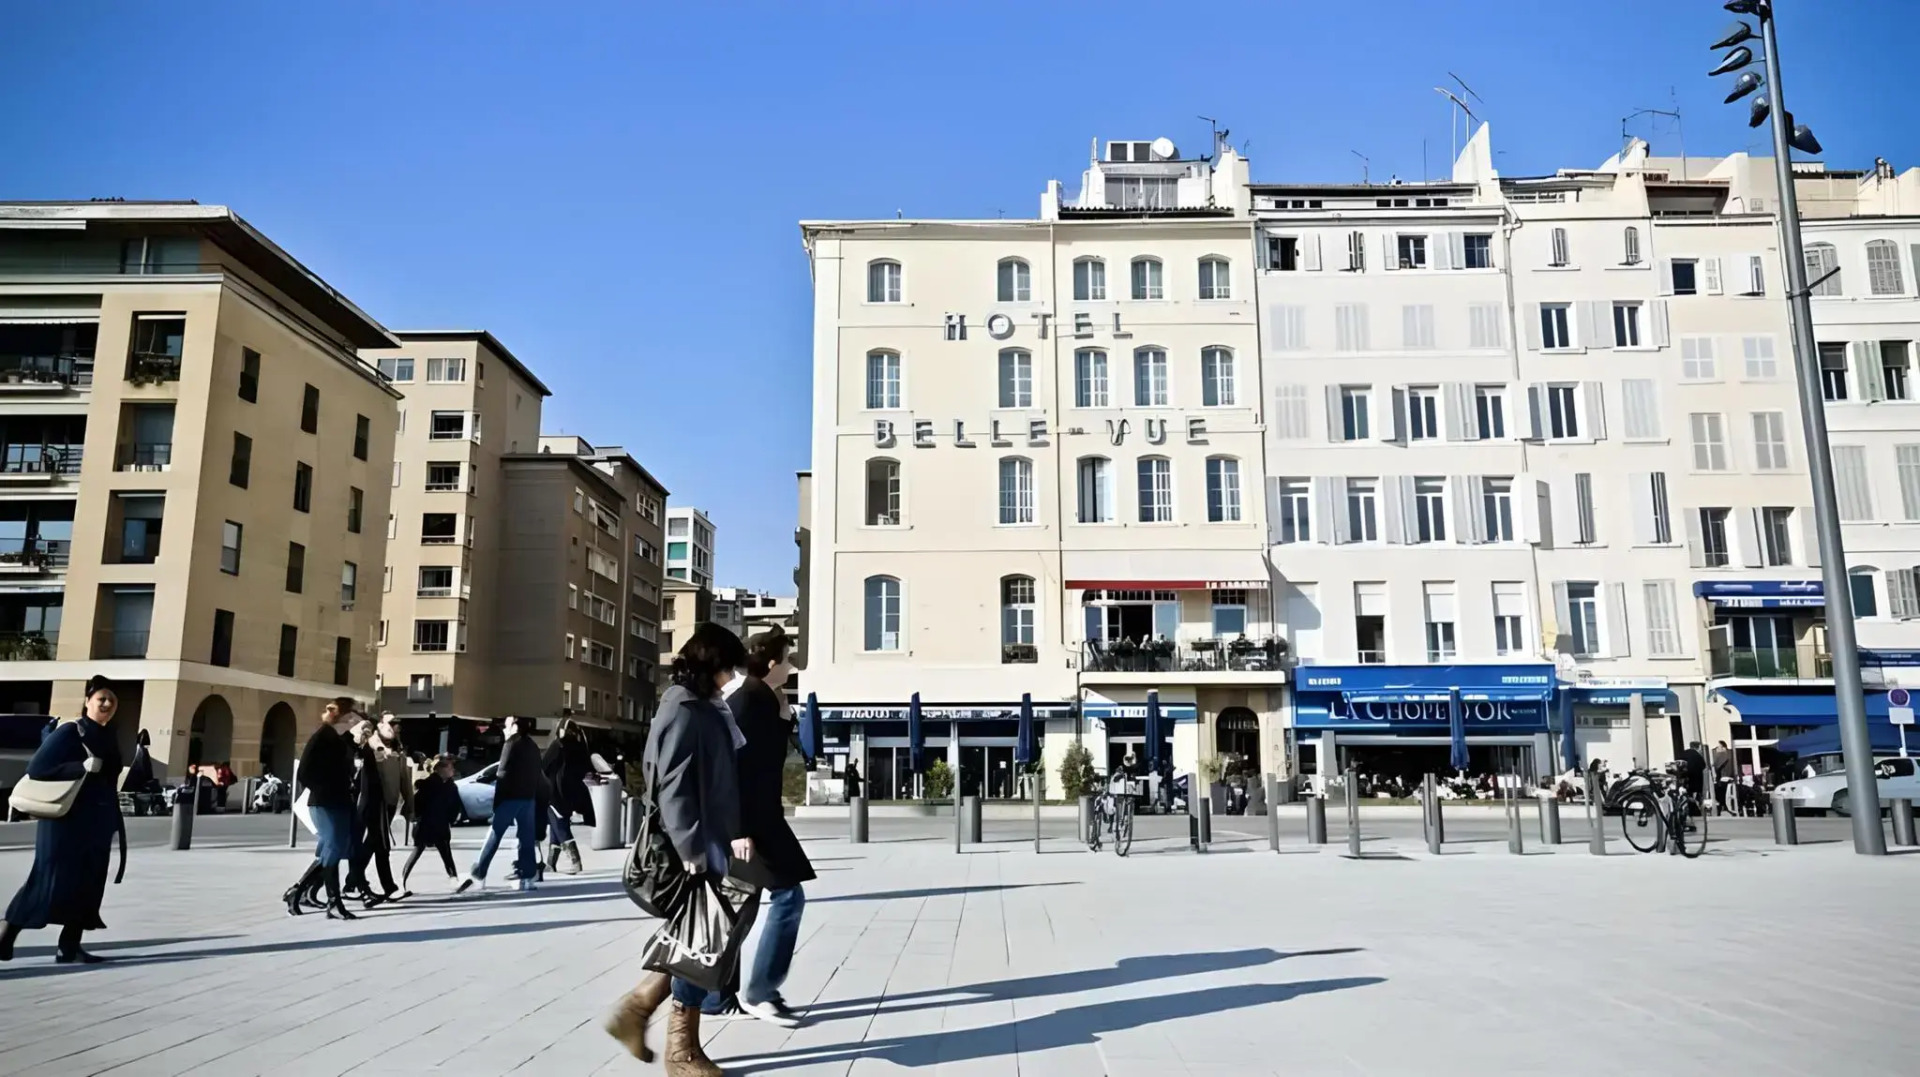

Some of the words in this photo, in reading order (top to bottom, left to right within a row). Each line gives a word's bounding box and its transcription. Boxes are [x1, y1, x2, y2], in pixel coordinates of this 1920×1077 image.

[944, 311, 1133, 341] HOTEL
[873, 418, 1051, 449] BELLE
[1105, 417, 1210, 447] VUE
[1366, 700, 1446, 720] CHOPE
